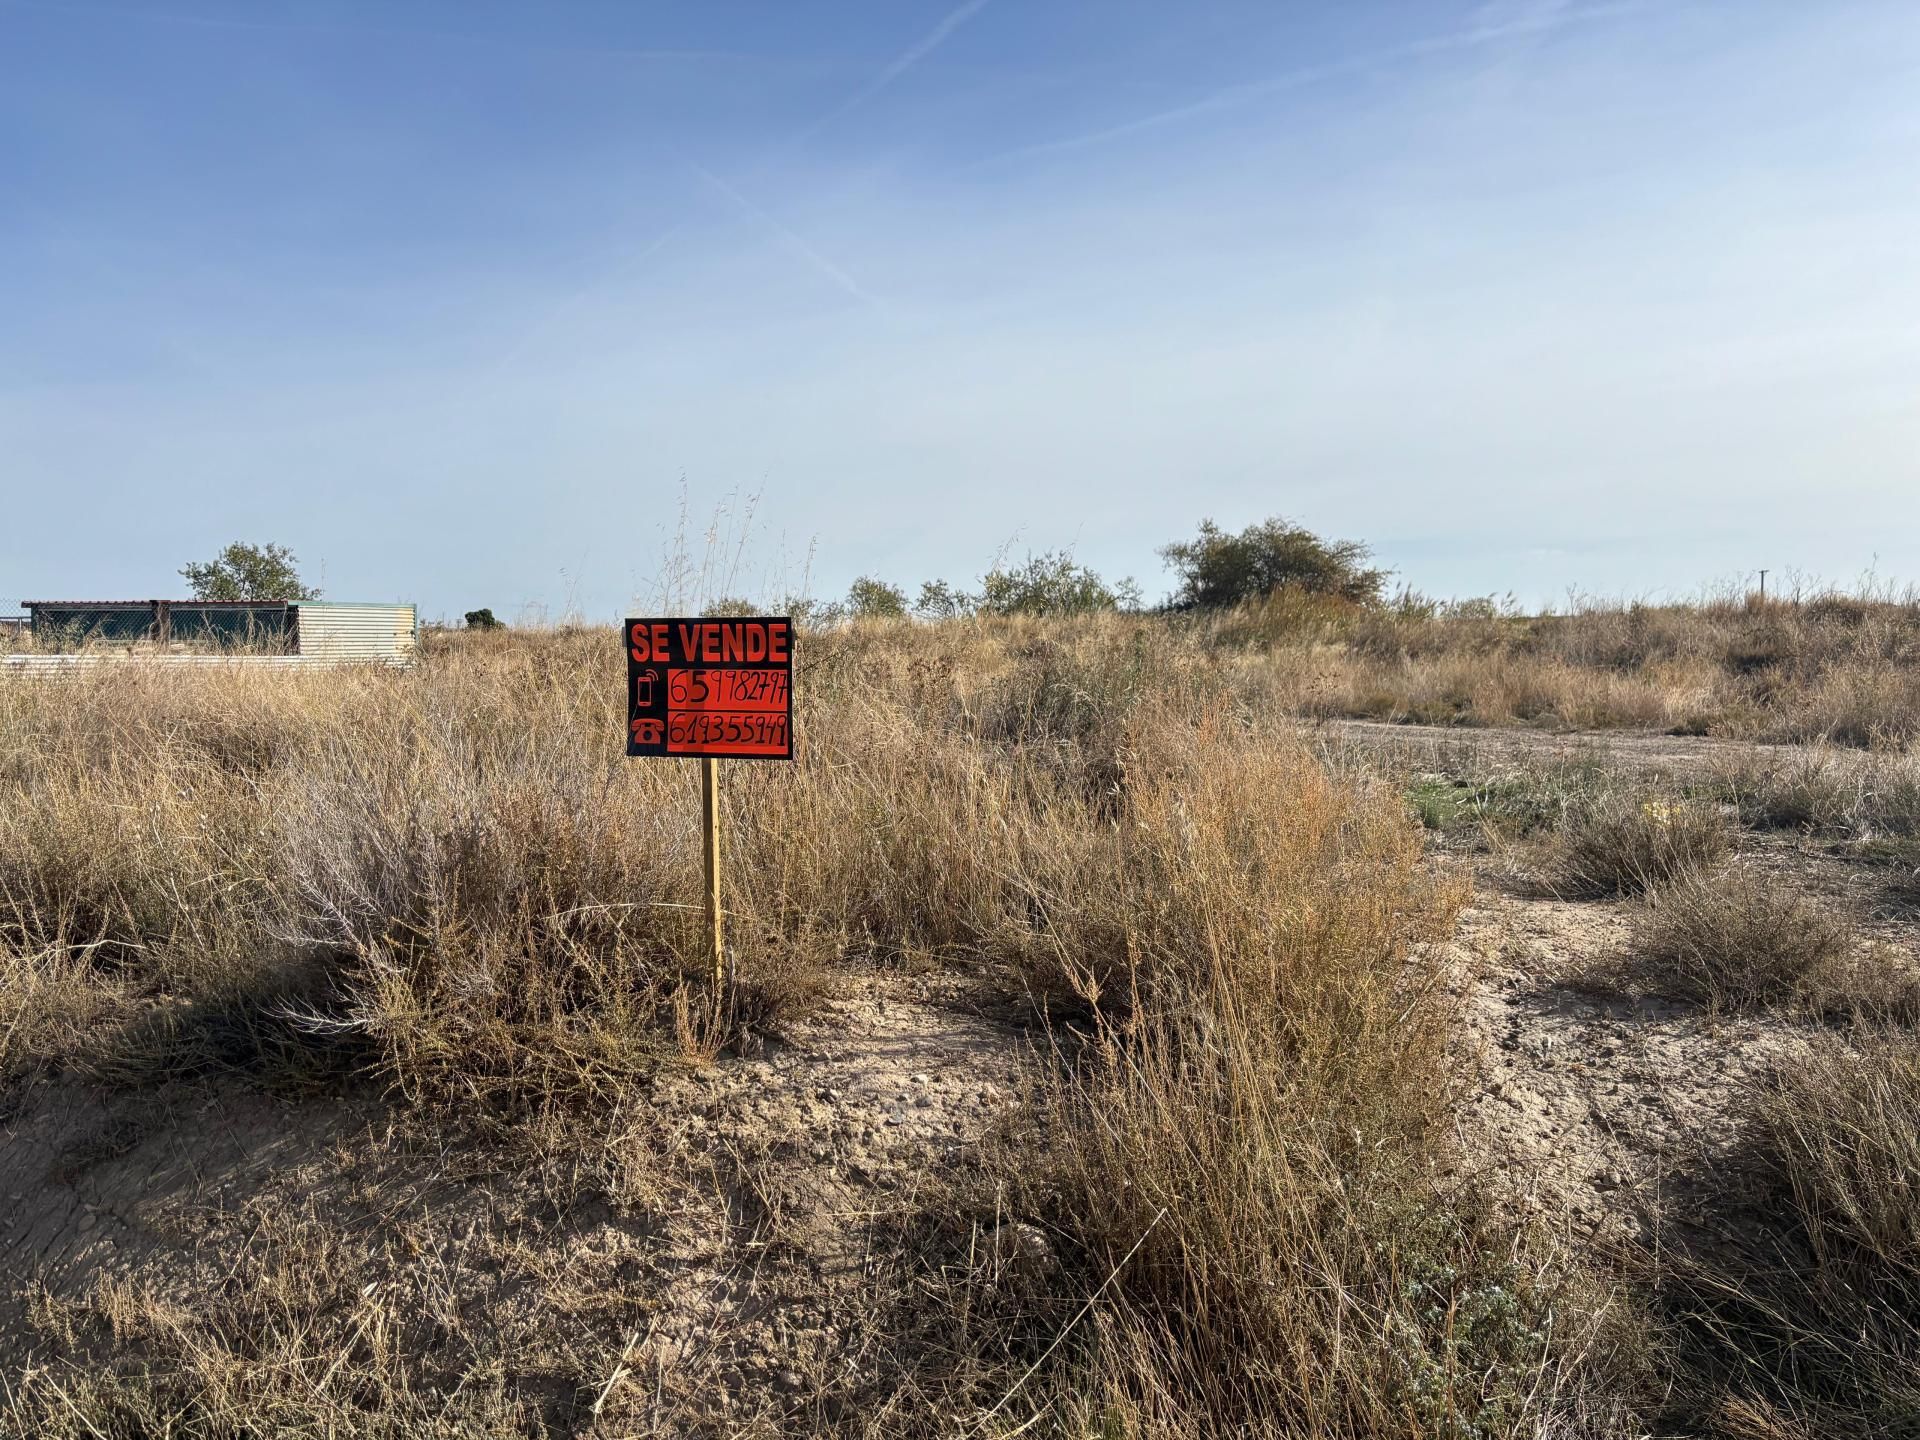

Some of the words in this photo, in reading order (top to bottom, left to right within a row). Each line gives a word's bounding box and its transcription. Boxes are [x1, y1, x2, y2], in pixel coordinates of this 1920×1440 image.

[631, 623, 670, 662] SE
[678, 623, 788, 662] VENDE
[670, 670, 788, 704] 659982797
[669, 713, 788, 747] 619355949
